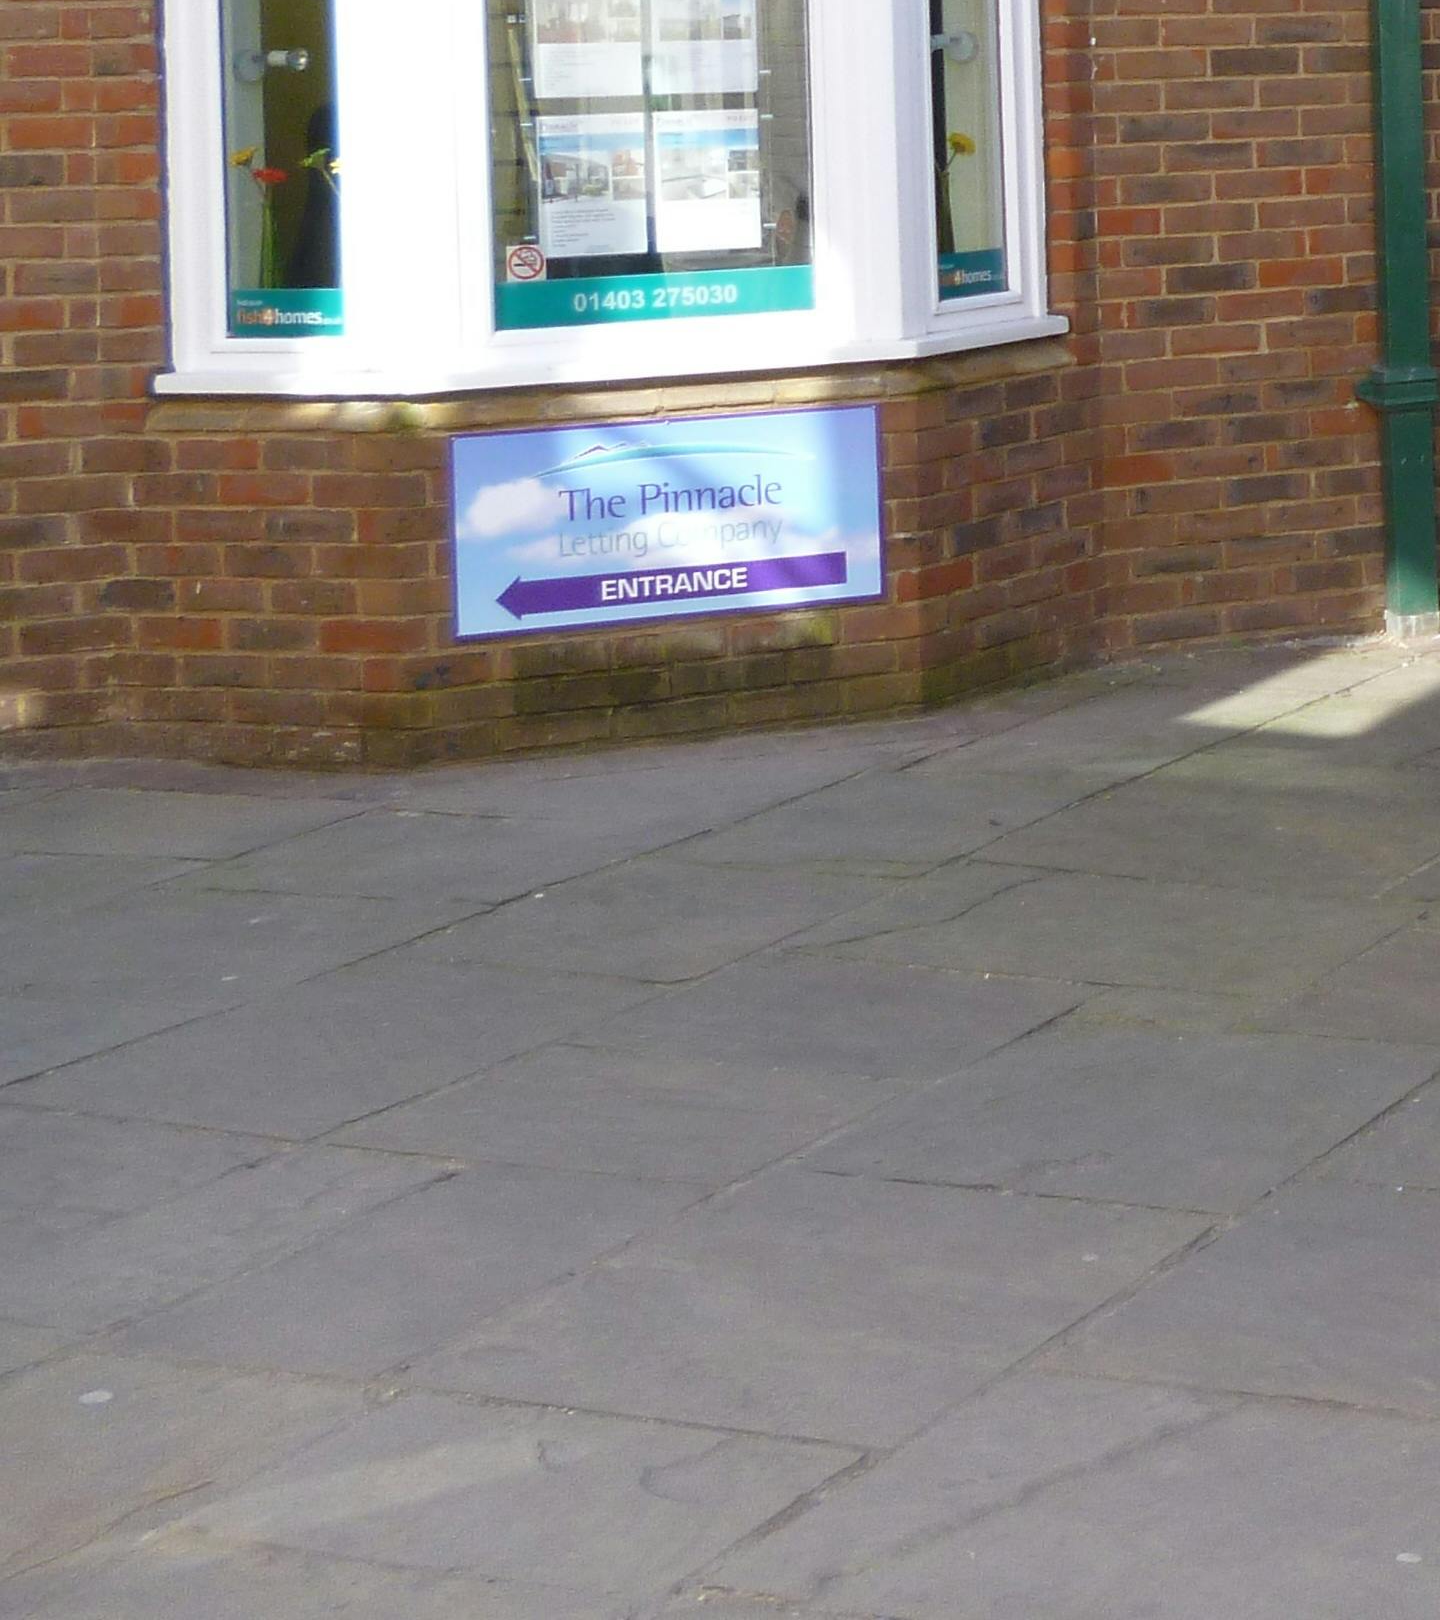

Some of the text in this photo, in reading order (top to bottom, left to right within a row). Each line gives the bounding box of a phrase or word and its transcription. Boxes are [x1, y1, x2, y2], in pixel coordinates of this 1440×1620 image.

[573, 284, 738, 312] 01403 275030
[559, 474, 783, 522] The Pinnacle
[558, 528, 648, 558] Letting
[601, 566, 748, 601] ENTRANCE
